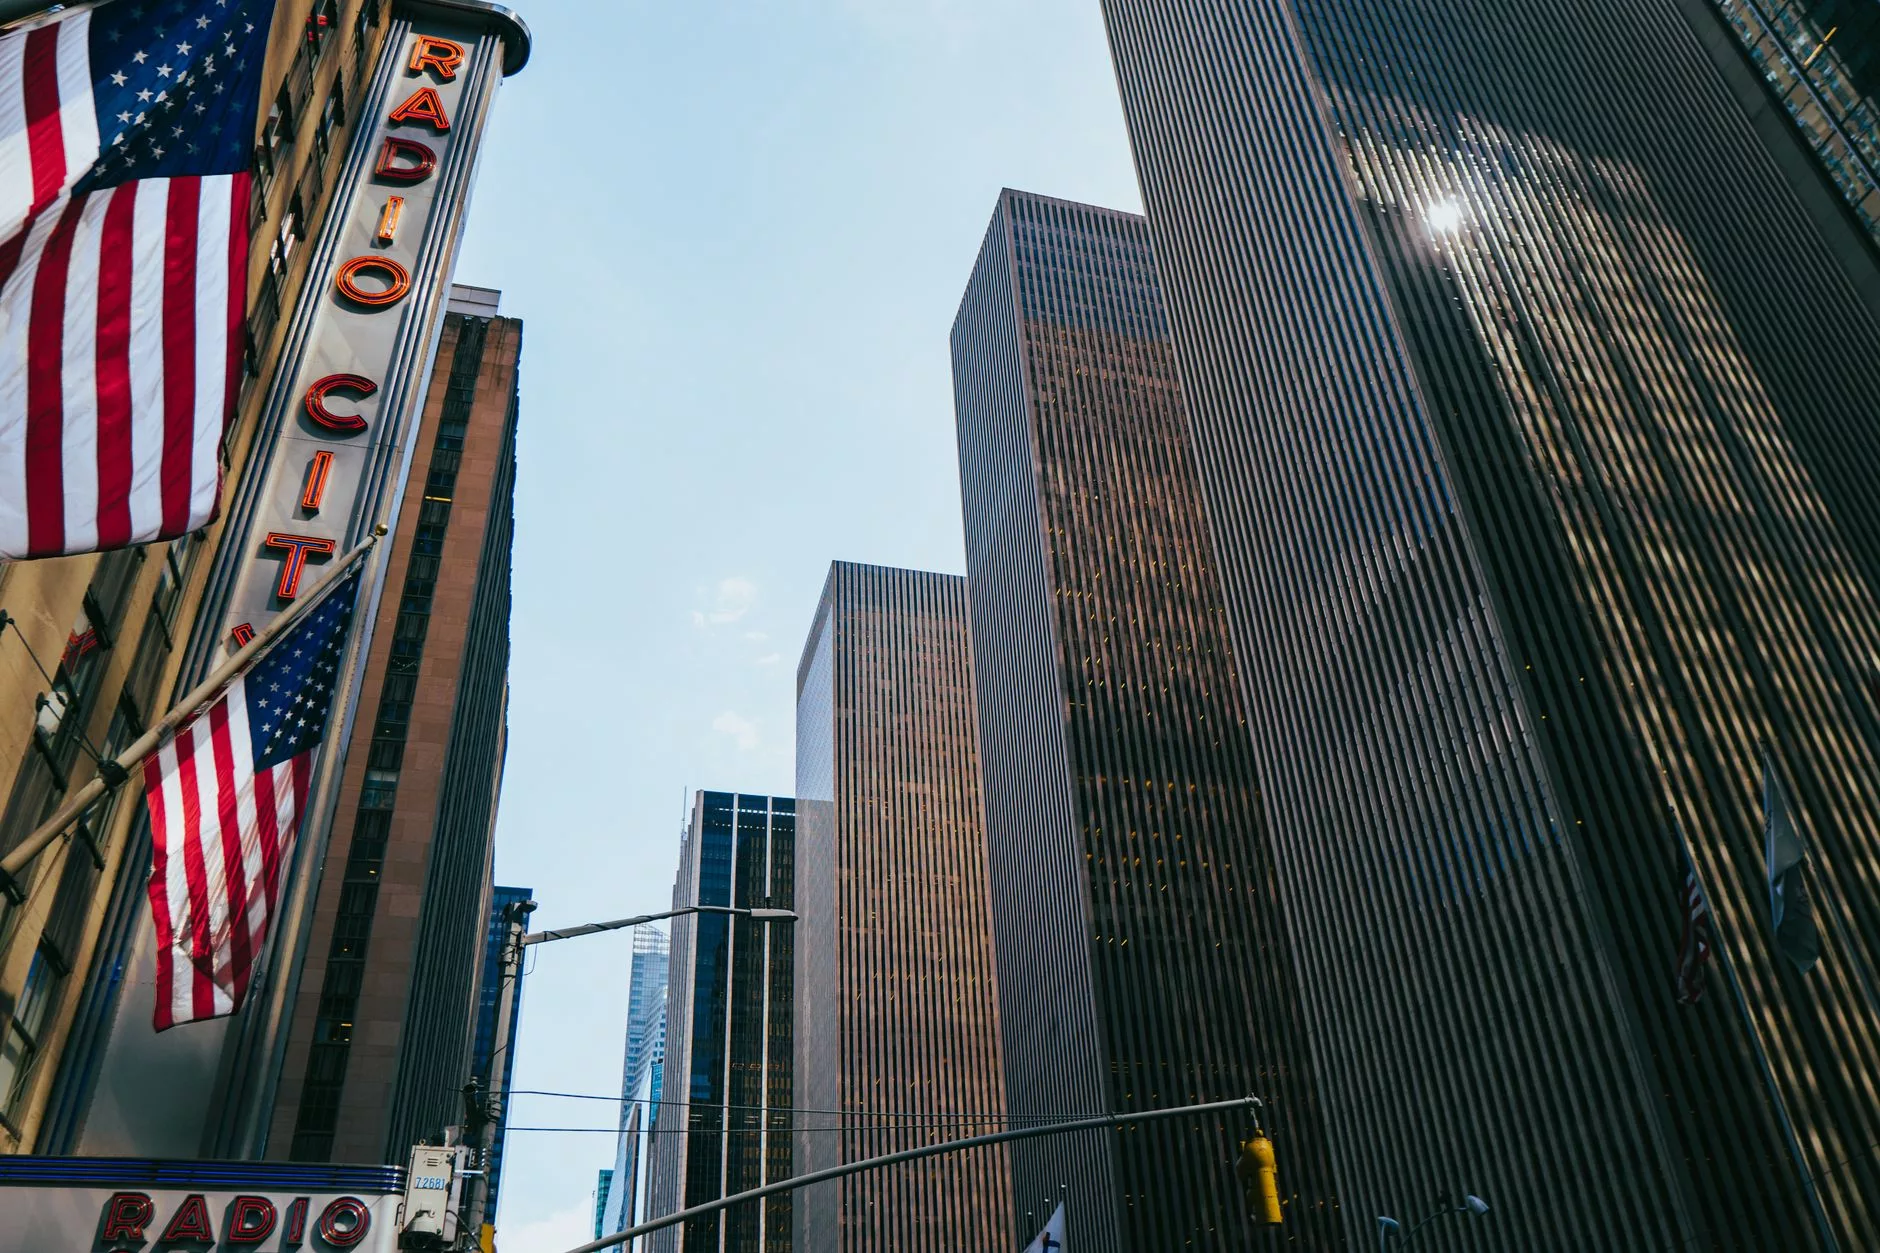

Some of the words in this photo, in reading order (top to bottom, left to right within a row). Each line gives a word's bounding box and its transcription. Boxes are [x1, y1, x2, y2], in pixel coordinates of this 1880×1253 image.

[336, 35, 465, 306] RADIO
[232, 373, 377, 648] CIT
[102, 1192, 371, 1246] RADIO
